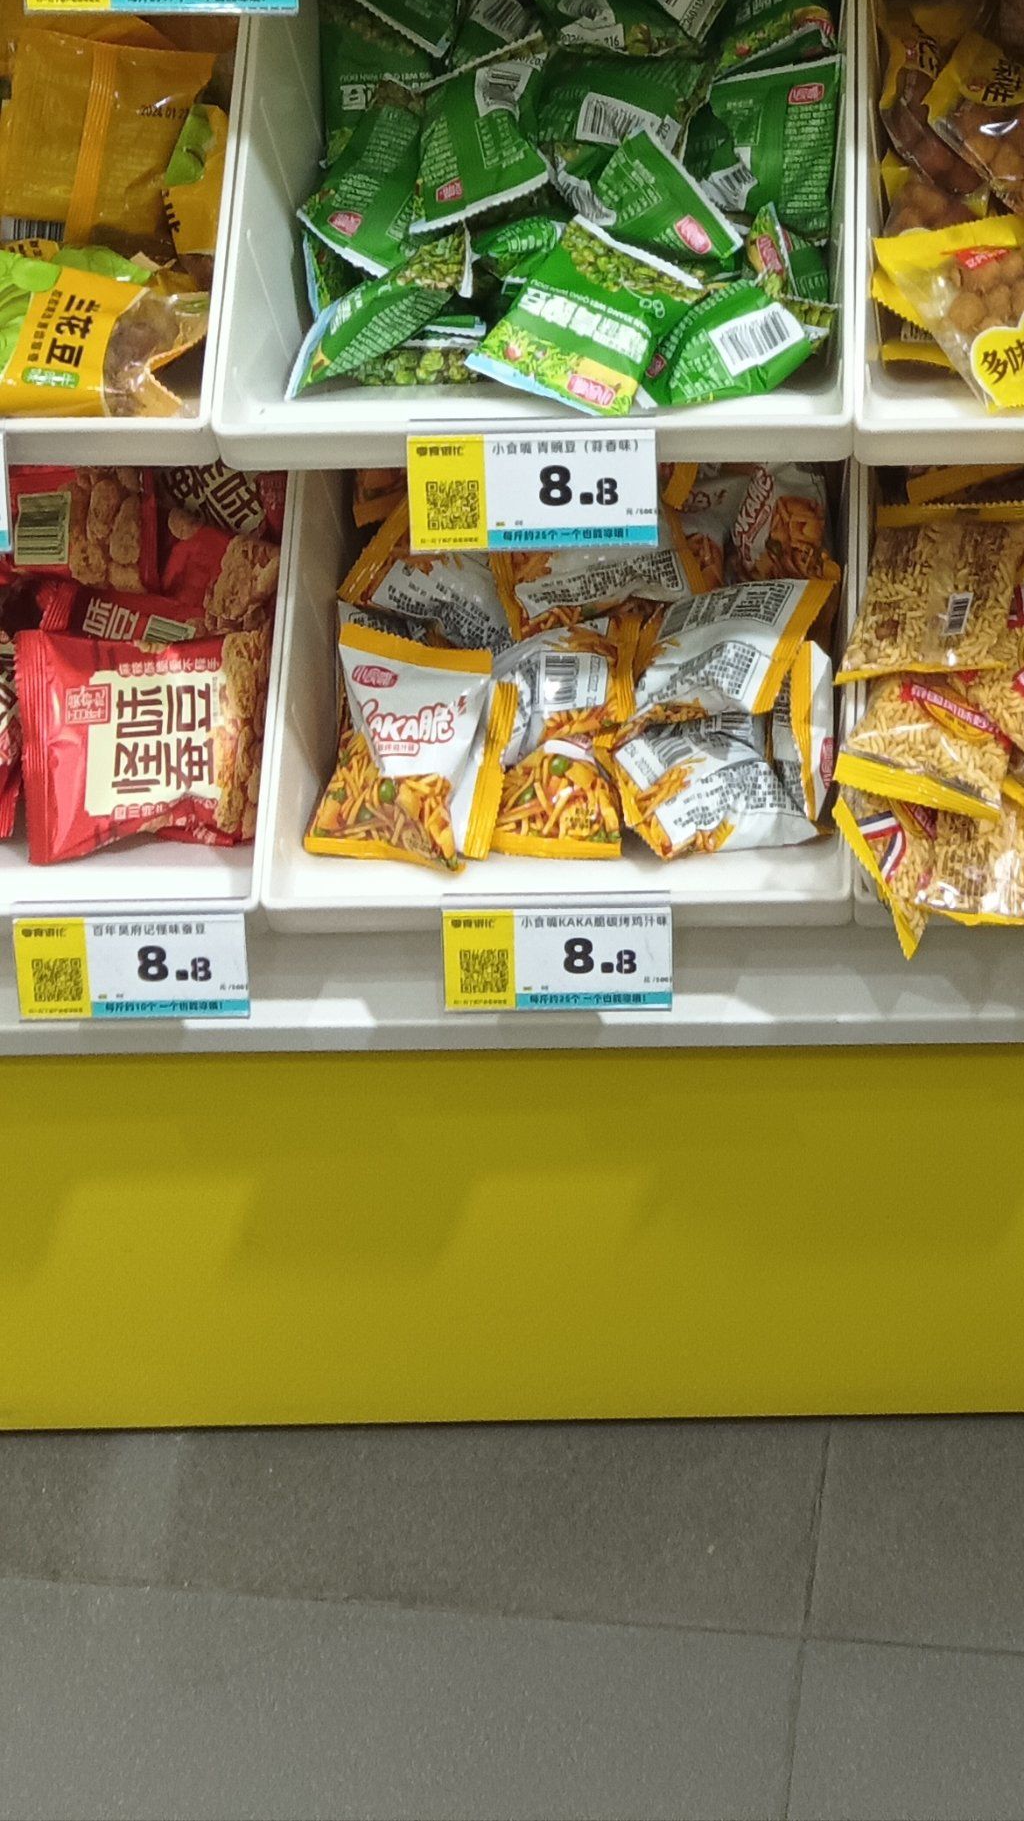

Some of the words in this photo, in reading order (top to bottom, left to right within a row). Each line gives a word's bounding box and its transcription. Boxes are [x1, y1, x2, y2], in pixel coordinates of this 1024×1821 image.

[538, 464, 619, 507] 8.8
[112, 683, 163, 795] 怪味
[164, 680, 214, 792] 蚕豆
[137, 945, 212, 982] 8.8
[563, 937, 637, 975] 8.8
